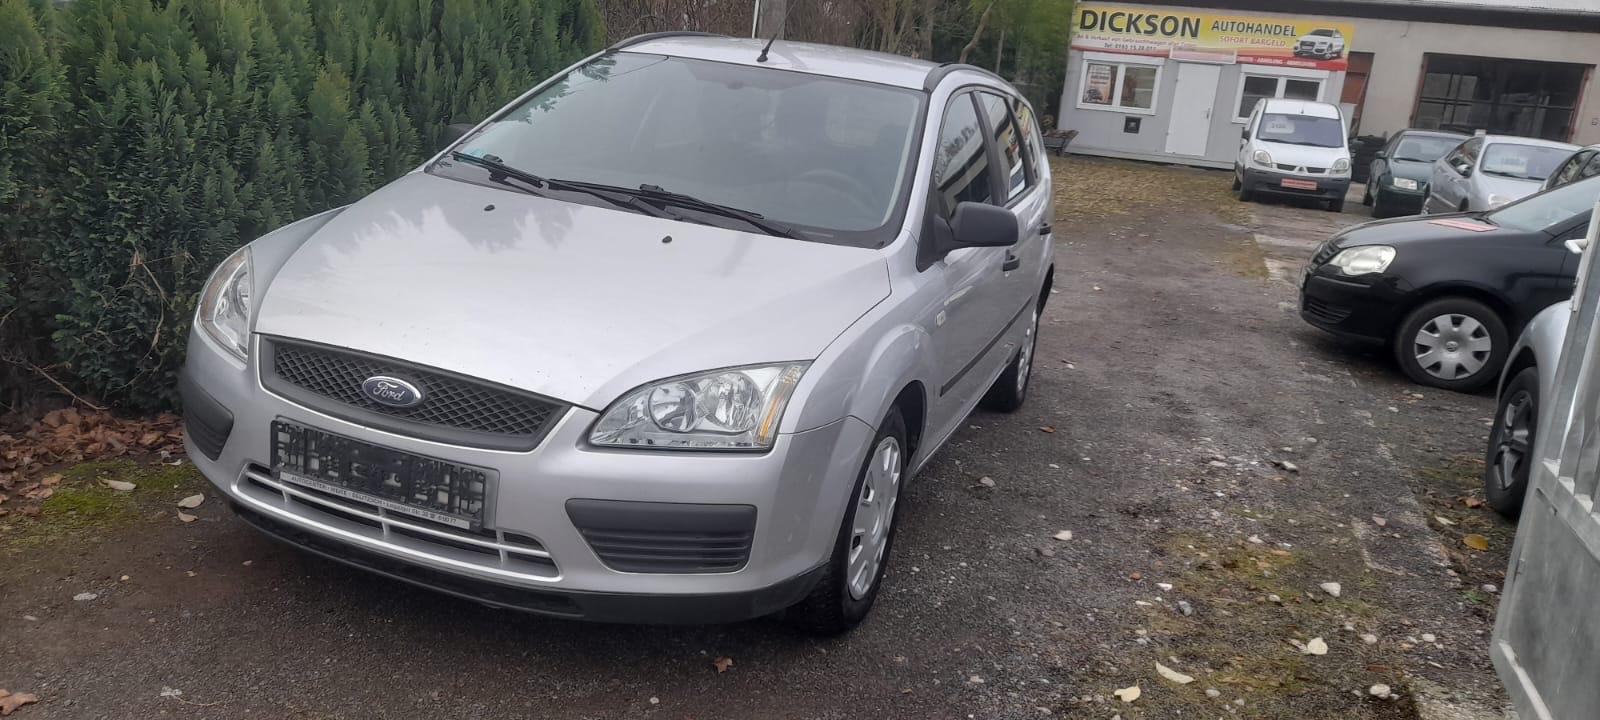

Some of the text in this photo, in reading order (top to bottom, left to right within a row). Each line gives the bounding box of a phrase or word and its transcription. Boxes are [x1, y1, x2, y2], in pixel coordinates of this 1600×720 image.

[1080, 10, 1200, 38] DICKSON
[1211, 20, 1296, 37] AUTOHANDEL
[1219, 35, 1287, 47] SOFORT BARGELD
[373, 381, 405, 401] Ford
